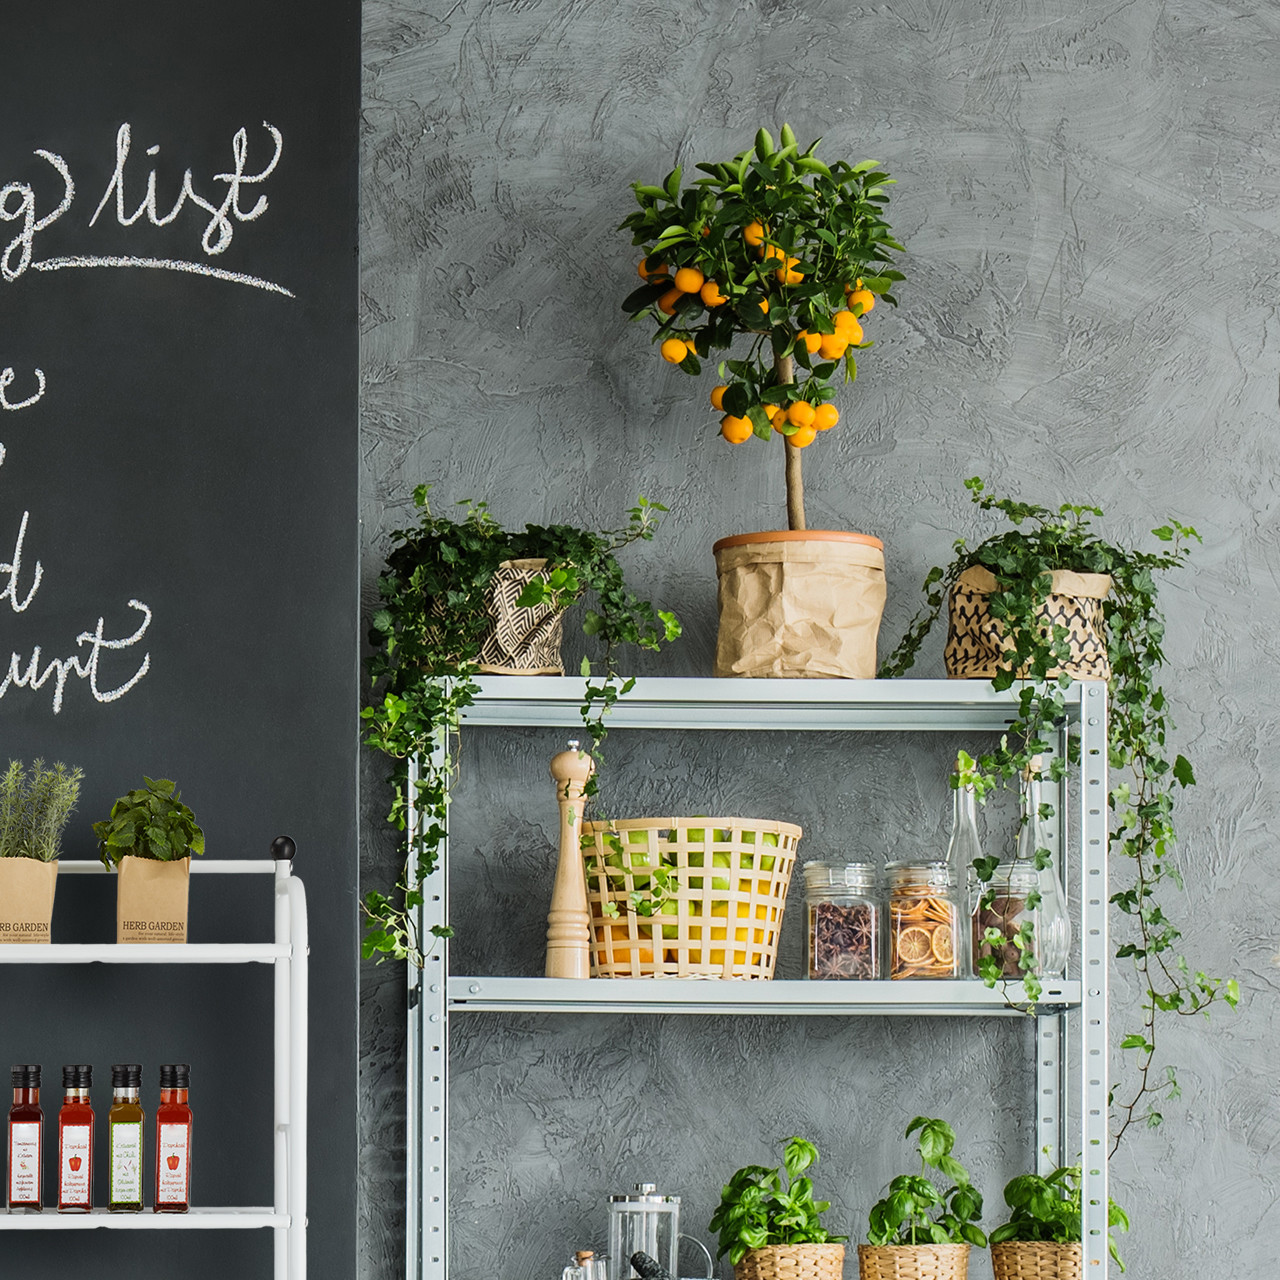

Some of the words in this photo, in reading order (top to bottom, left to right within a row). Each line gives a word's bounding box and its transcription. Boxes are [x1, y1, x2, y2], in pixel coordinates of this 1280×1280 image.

[89, 120, 282, 256] list
[12, 922, 49, 932] GARDEN
[122, 920, 147, 930] HERB
[148, 921, 185, 931] GARDEN
